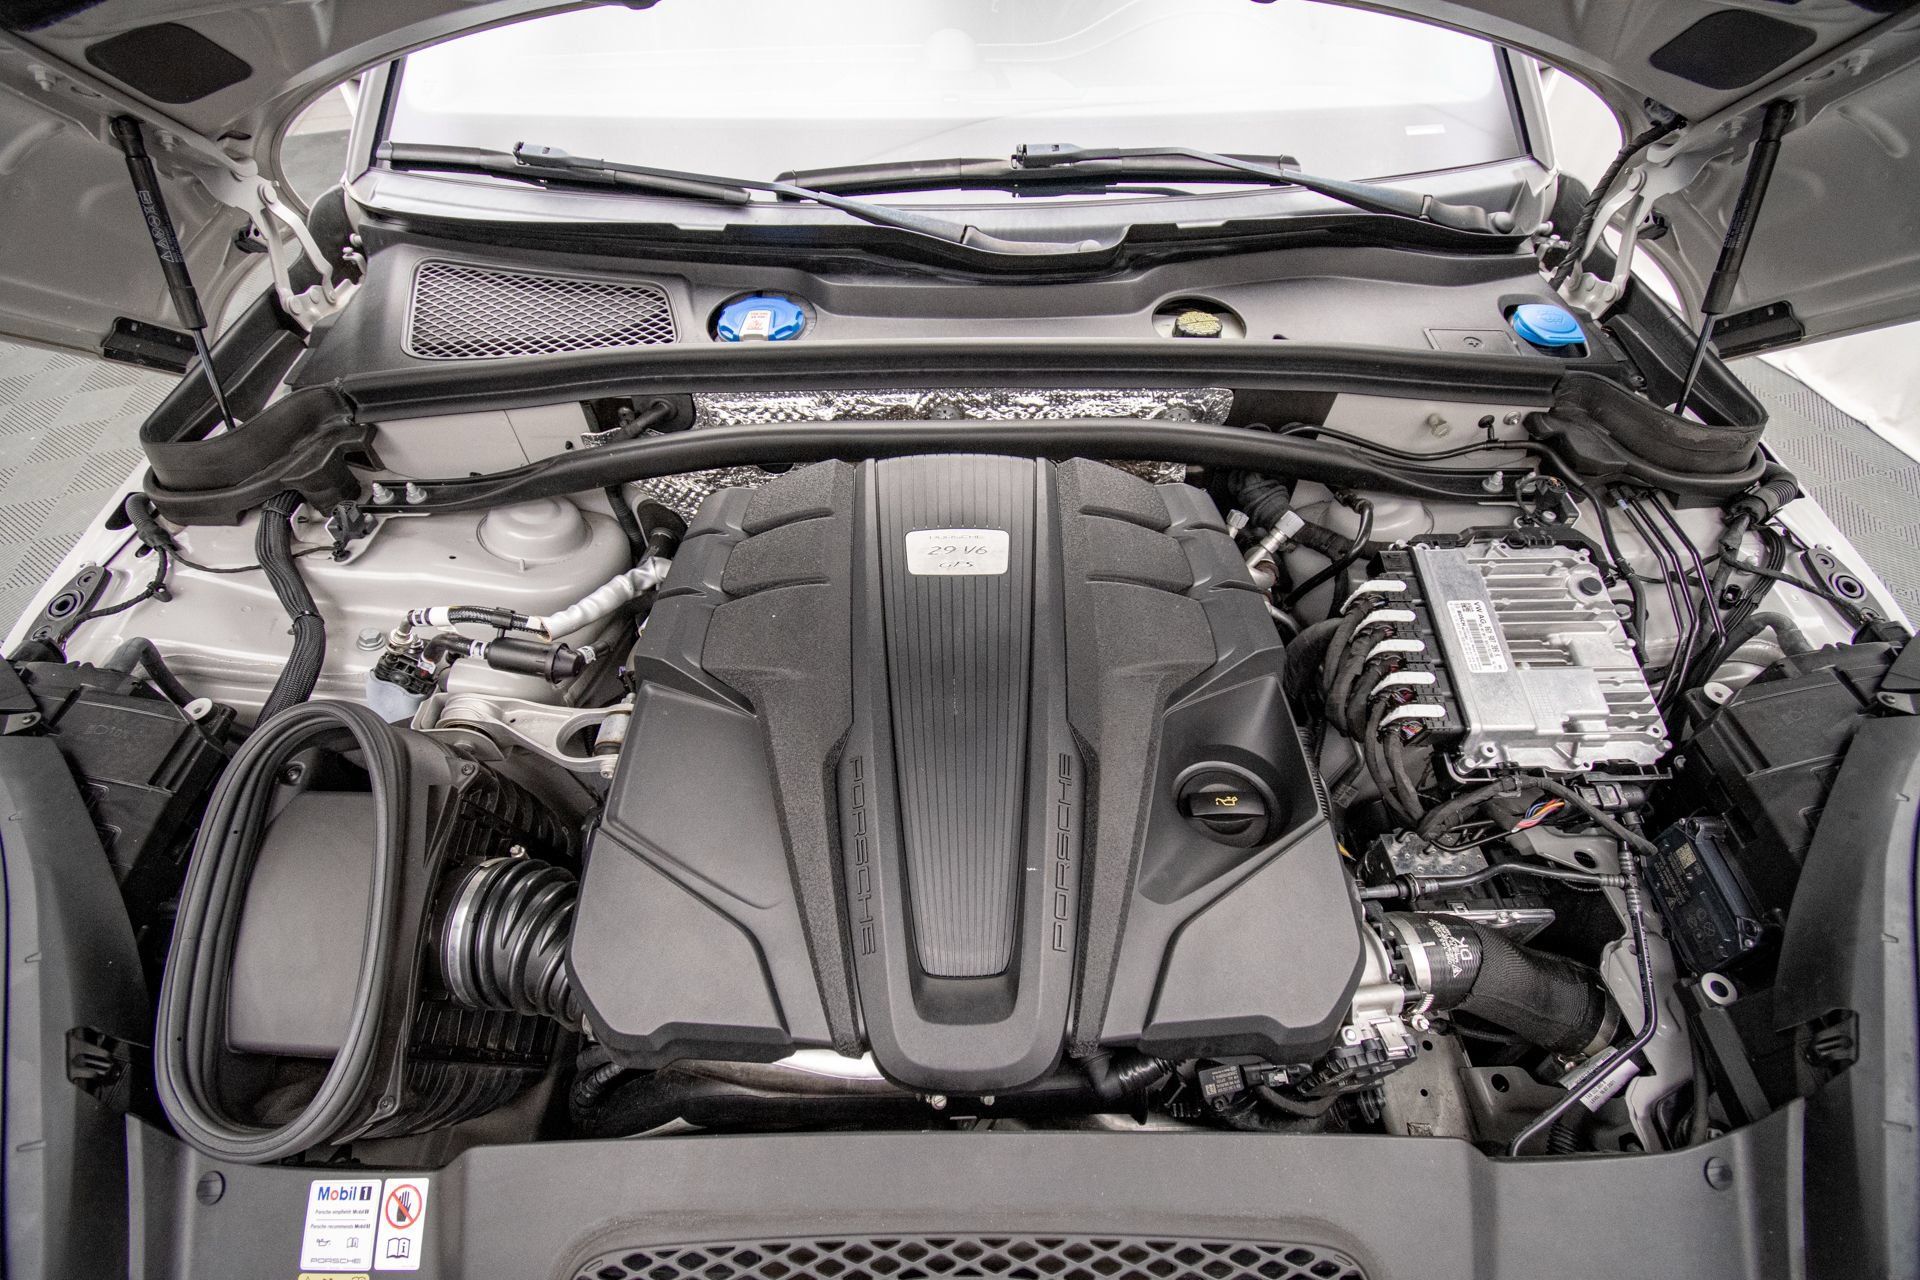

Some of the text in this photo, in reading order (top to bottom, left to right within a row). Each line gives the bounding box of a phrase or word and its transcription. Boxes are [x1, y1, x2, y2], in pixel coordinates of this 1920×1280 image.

[964, 545, 988, 555] V6
[1457, 610, 1466, 626] BOSCH
[1474, 602, 1482, 612] VW
[1478, 614, 1487, 625] AG
[850, 755, 876, 956] PORSCHE
[1053, 753, 1072, 953] PORSCHE
[317, 1186, 372, 1200] Mobil 1
